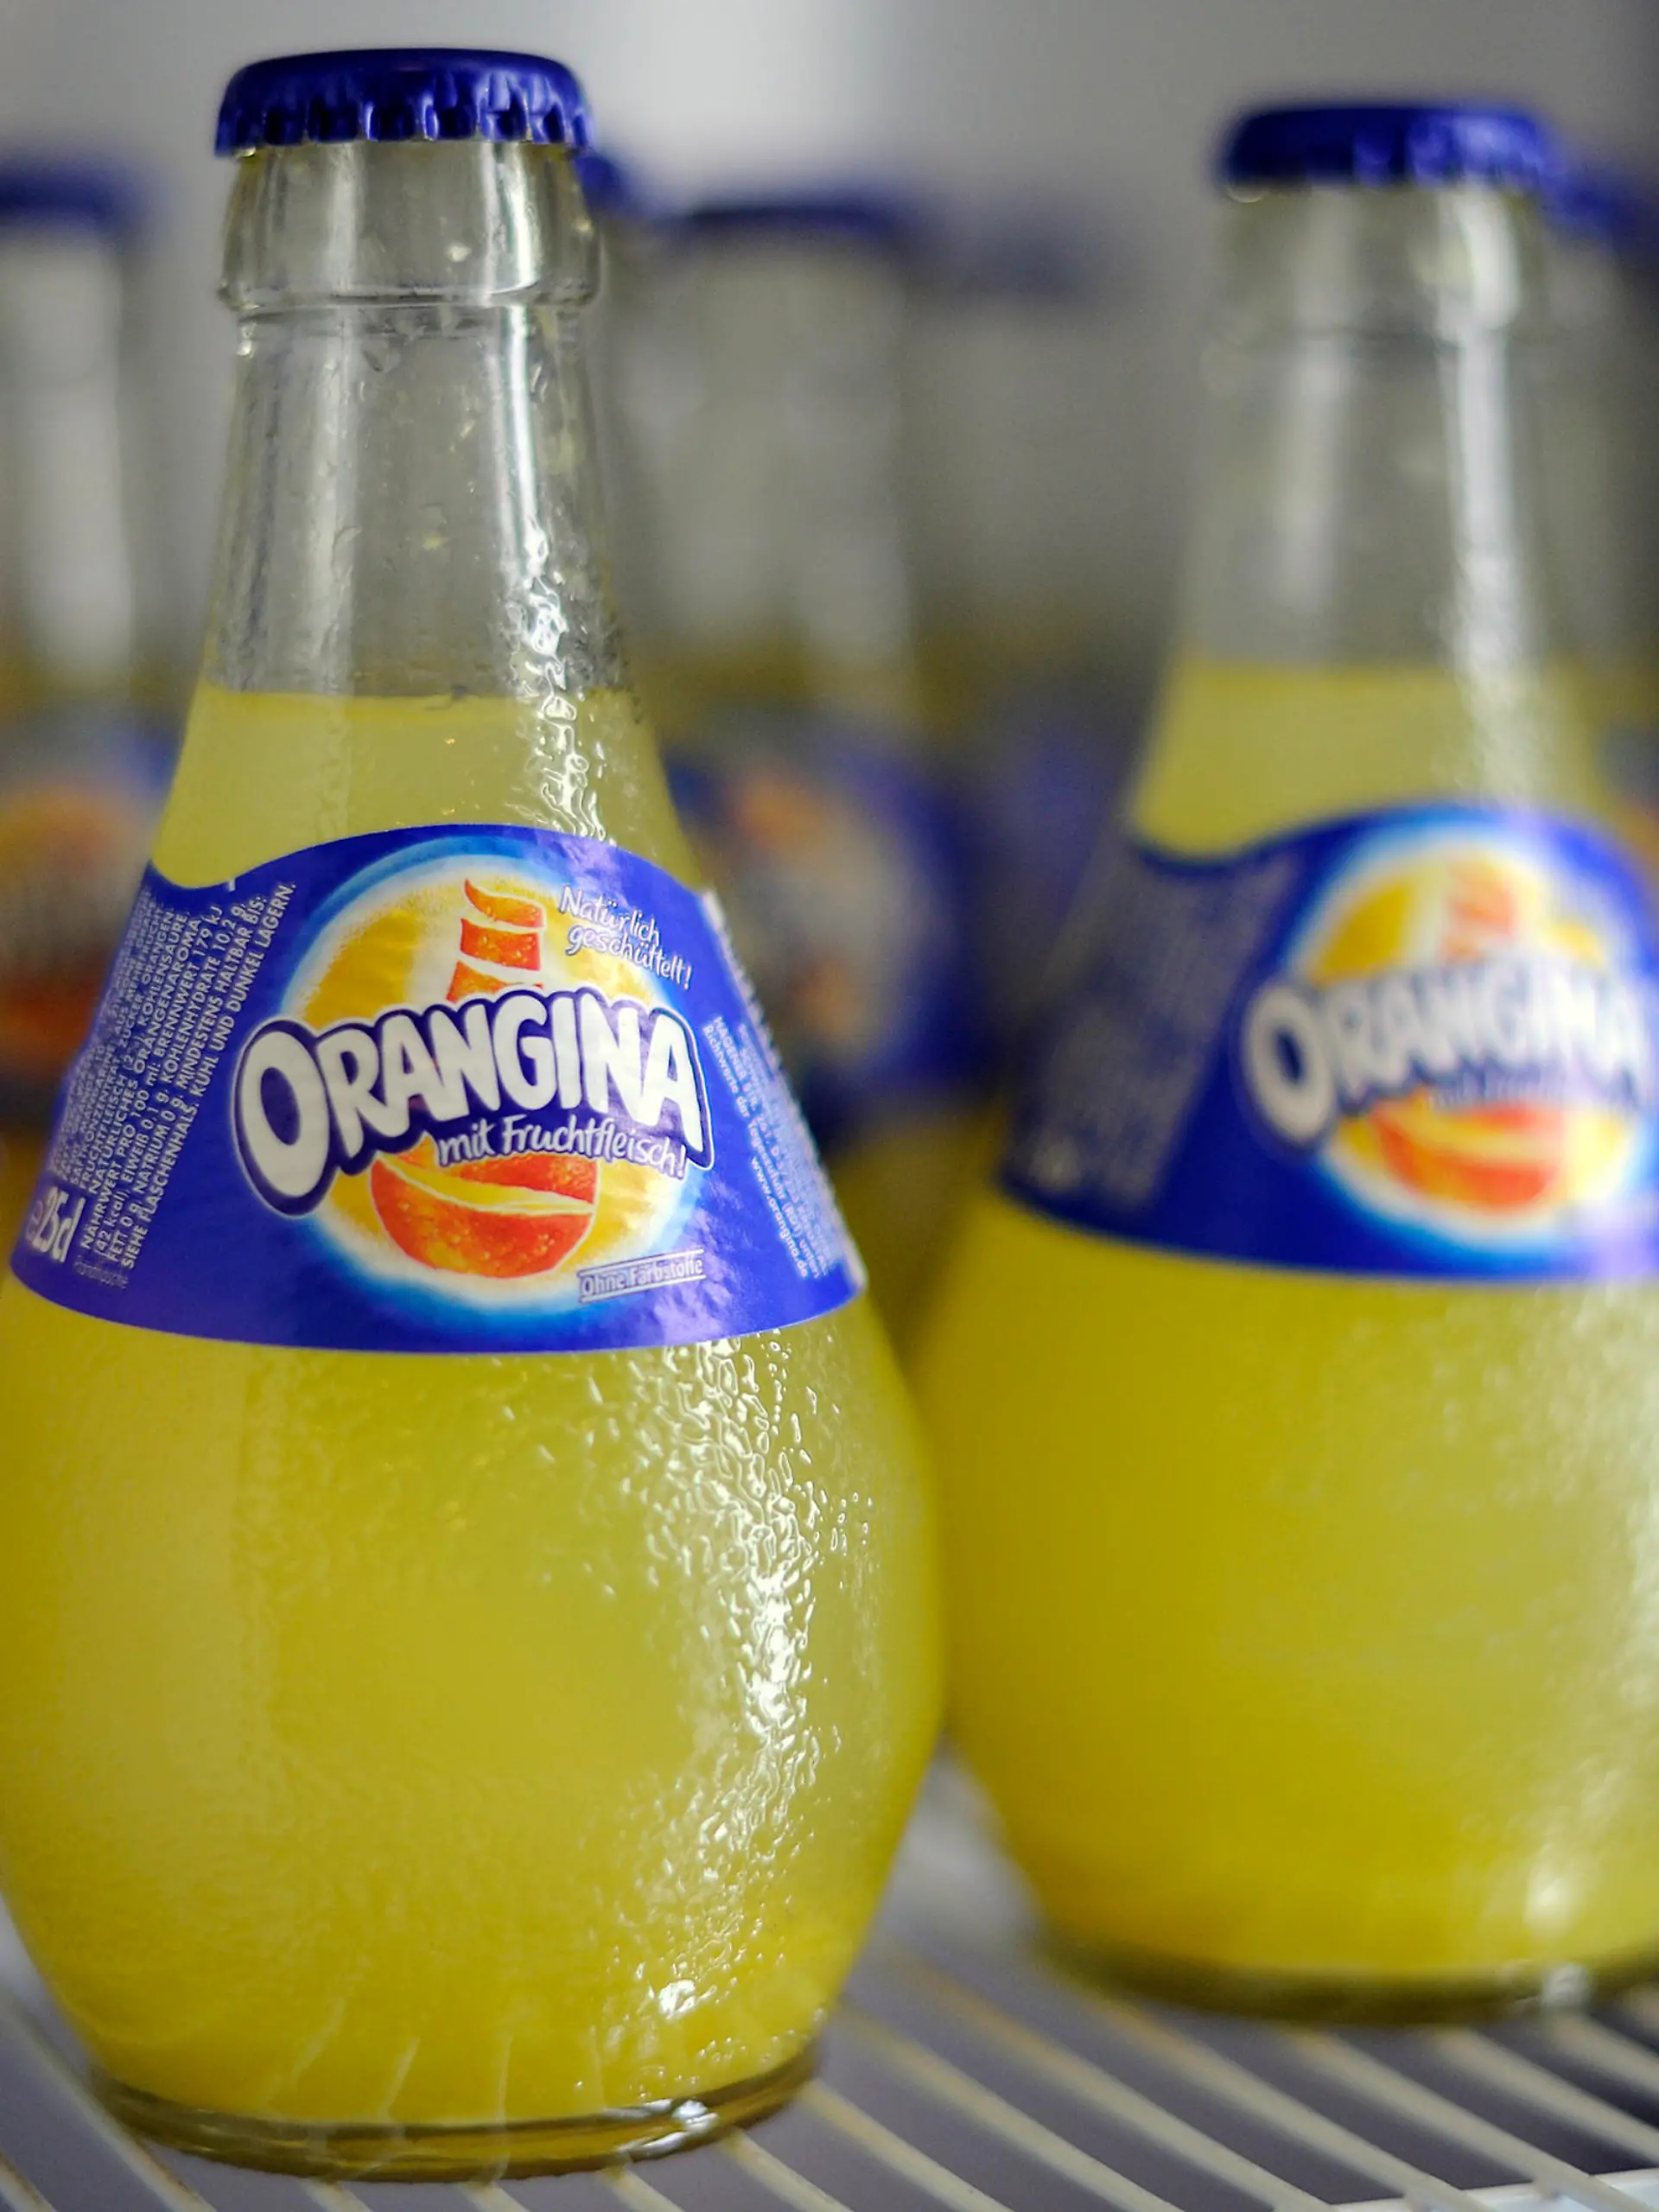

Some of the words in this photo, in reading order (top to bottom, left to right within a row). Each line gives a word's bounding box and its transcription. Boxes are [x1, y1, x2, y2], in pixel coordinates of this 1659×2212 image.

[559, 885, 660, 947] Natürlich
[566, 924, 692, 990] geschüttelt!
[114, 1122, 137, 1157] PRO
[129, 1088, 150, 1119] 100
[152, 961, 200, 1058] BRENNWERT
[192, 926, 214, 957] 179
[159, 955, 221, 1084] KOHLENHYDRATE
[213, 917, 238, 953] 10,2
[702, 1023, 741, 1094] Richtwerte
[734, 1094, 752, 1118] der
[1244, 950, 1647, 1142] ORANGINA
[105, 1229, 128, 1262] FETT
[132, 1122, 168, 1195] NATRIUM
[175, 994, 224, 1090] MINDESTENS
[213, 924, 253, 994] HALTBAR
[243, 893, 267, 925] BIS:
[121, 1224, 149, 1270] SIEHE
[139, 1098, 200, 1223] FLASCHENHALS.
[208, 1013, 236, 1052] UND
[225, 948, 264, 1013] DUNKEL
[255, 878, 296, 948] LAGERN.
[239, 992, 705, 1210] ORANGINA
[439, 1120, 494, 1165] mit
[503, 1114, 687, 1179] Fruchtfleisch!
[747, 1156, 810, 1278] www.orangina.de
[582, 1272, 626, 1297] Ohne
[629, 1255, 704, 1287] Farbstoffe
